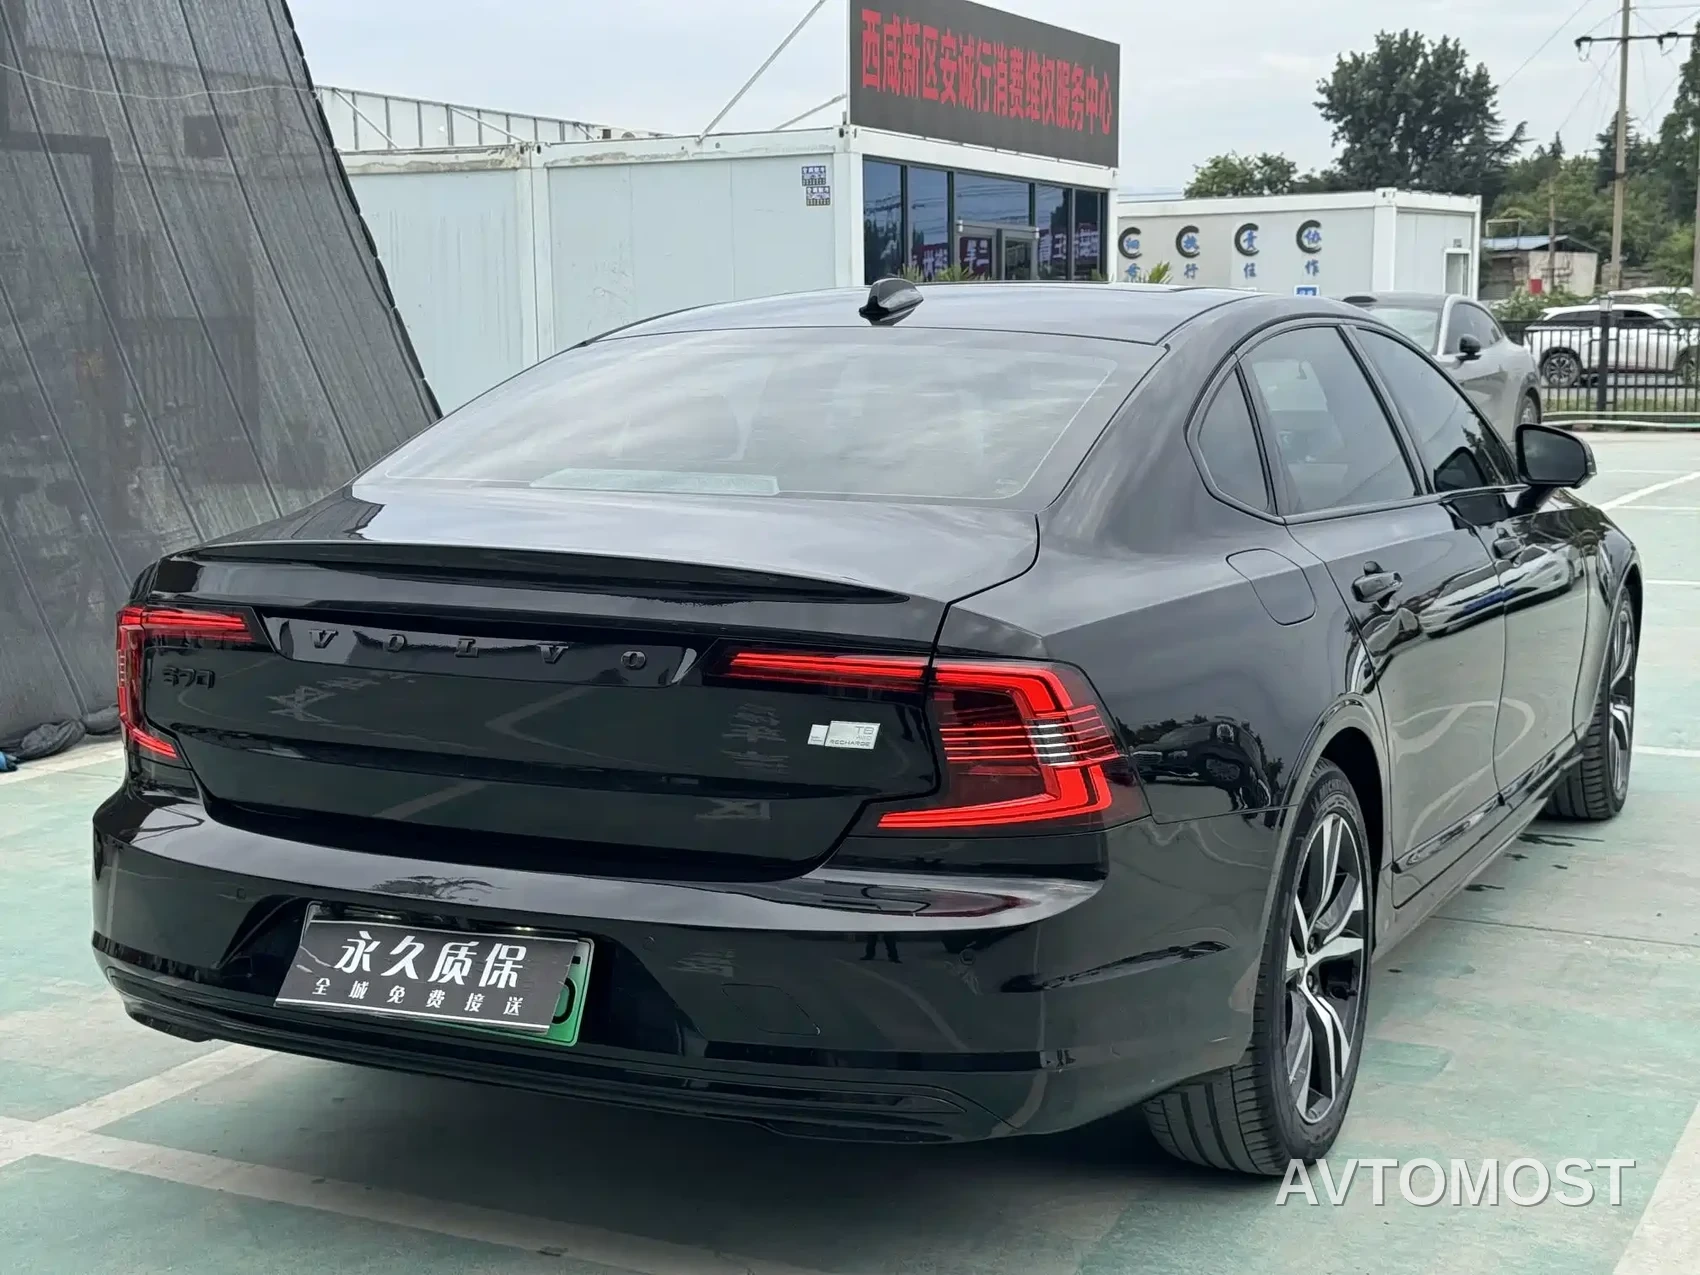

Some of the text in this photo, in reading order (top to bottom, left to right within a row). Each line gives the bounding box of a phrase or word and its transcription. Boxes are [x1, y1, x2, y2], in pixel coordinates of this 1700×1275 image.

[1304, 228, 1322, 276] 协作
[308, 628, 647, 671] VOLVO
[829, 739, 872, 747] RECHARGE
[334, 930, 527, 989] 永久质保
[312, 977, 525, 1016] 全城免费接送
